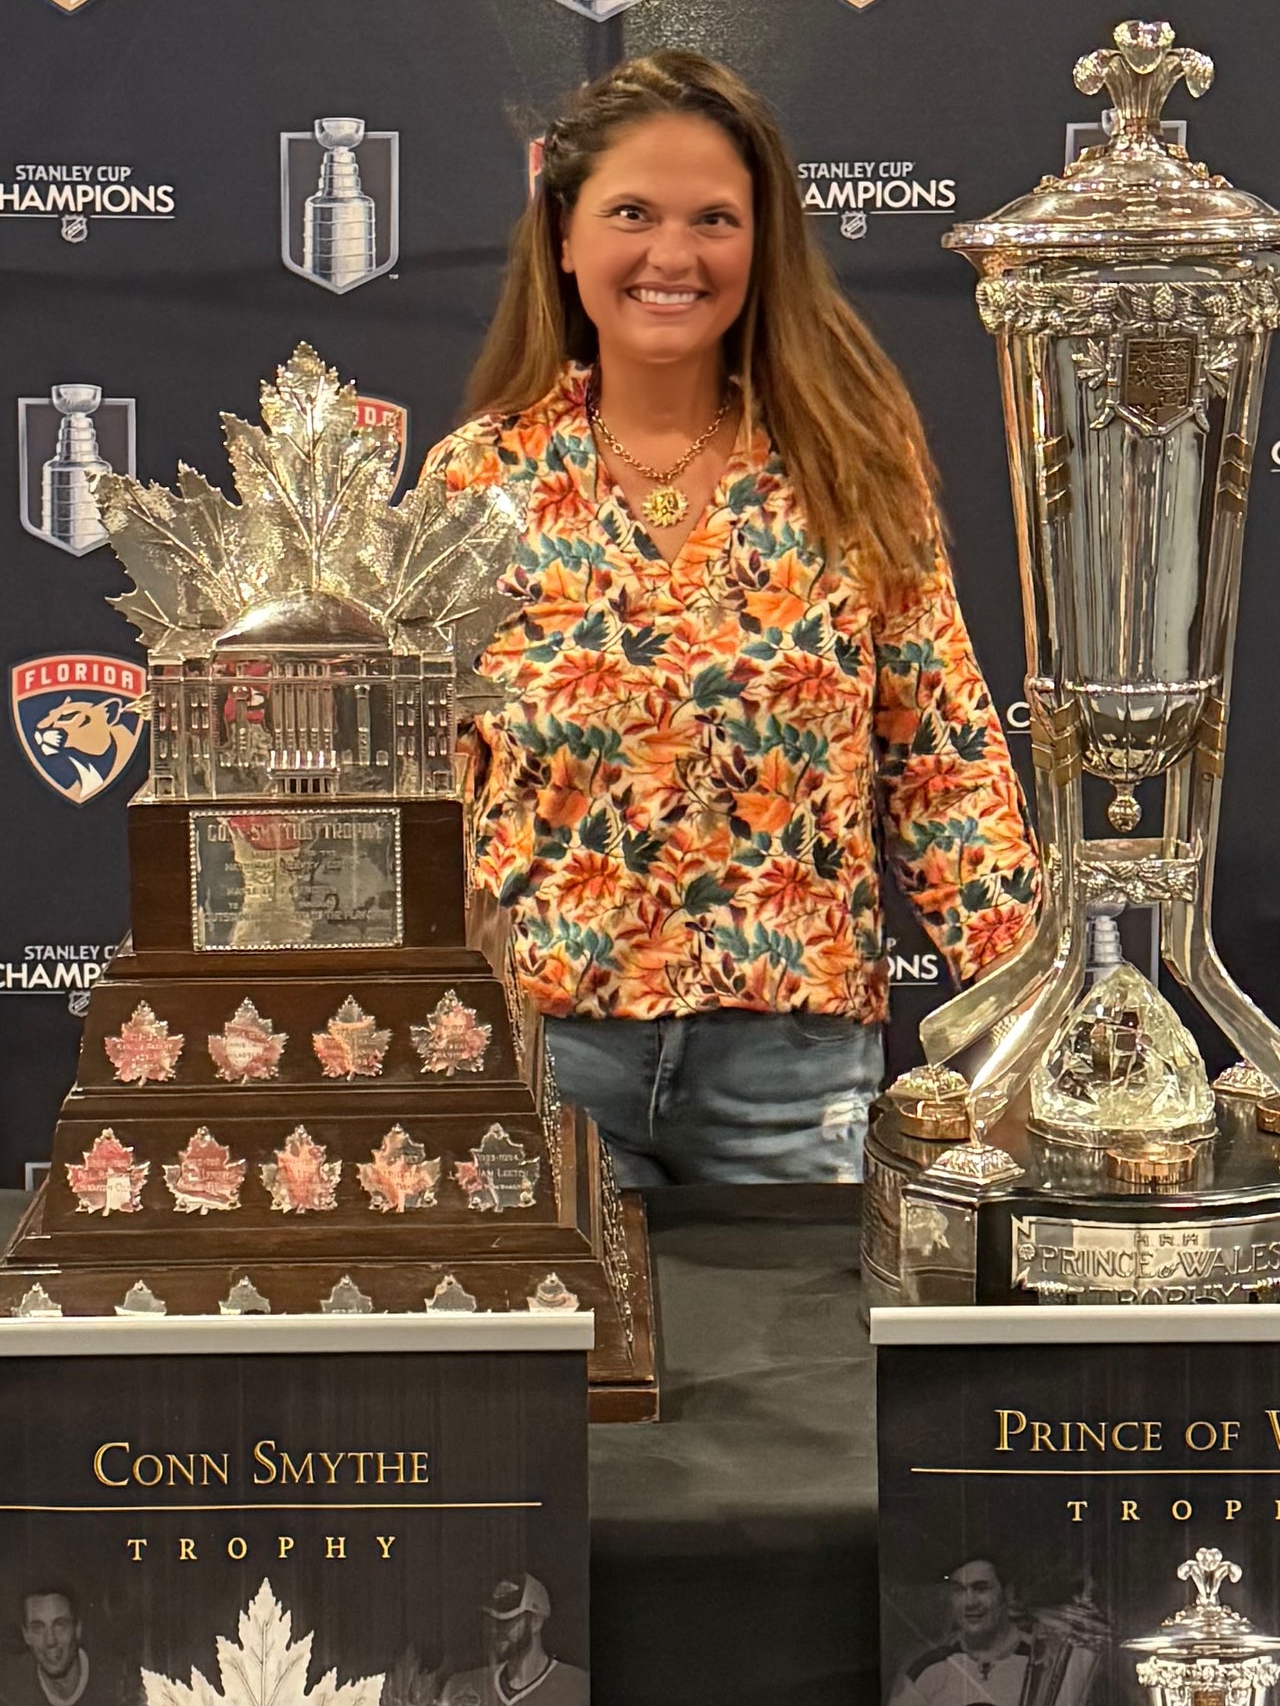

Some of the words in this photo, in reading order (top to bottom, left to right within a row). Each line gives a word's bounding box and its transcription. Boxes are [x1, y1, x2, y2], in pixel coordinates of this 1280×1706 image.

[16, 165, 92, 181] STANLEY
[97, 166, 131, 181] CUP
[798, 162, 875, 179] STANLEY
[879, 162, 913, 177] CUP
[803, 180, 956, 208] AMPIONS
[26, 663, 133, 689] FLORIDA
[25, 946, 99, 959] STANLEY
[127, 1536, 396, 1561] TROPHY
